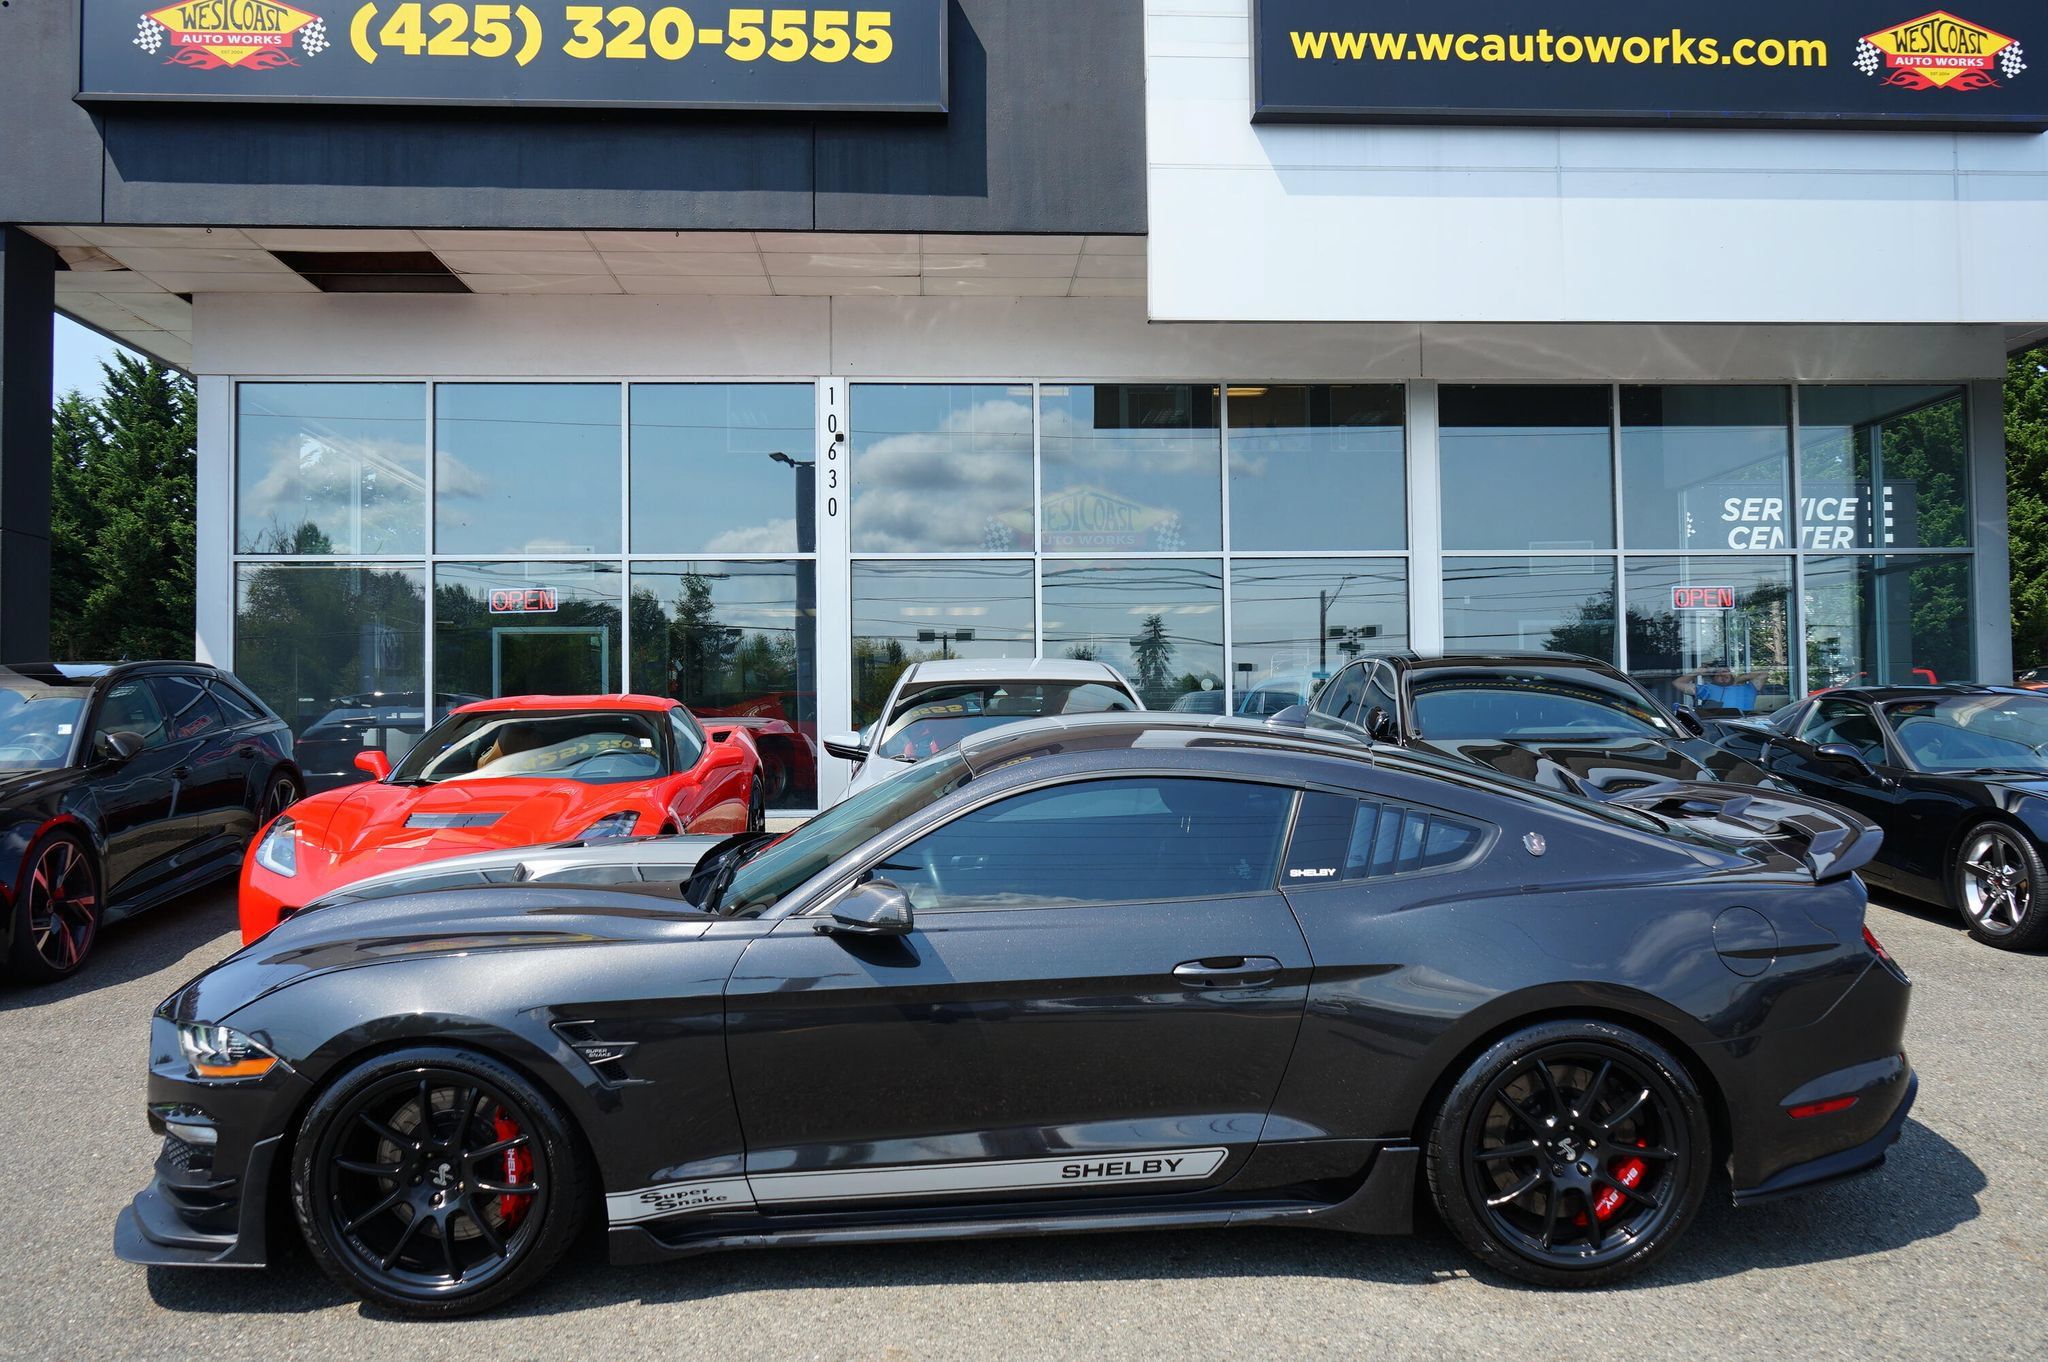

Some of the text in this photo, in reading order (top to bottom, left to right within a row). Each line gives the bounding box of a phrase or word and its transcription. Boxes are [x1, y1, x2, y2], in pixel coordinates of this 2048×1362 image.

[181, 34, 282, 44] AUTO WORKS
[350, 2, 893, 66] (425) 320-5555
[1290, 29, 1827, 67] www.wcautoworks.com
[1895, 57, 1984, 66] AUTO WORKS
[1721, 497, 1860, 521] SERICE
[1078, 535, 1136, 544] WORKS
[492, 589, 555, 611] OPEN
[1673, 588, 1733, 608] OPEN
[1289, 868, 1336, 877] SHELBY
[1061, 1158, 1184, 1179] SHELBY
[640, 1188, 710, 1204] Super
[654, 1195, 728, 1211] Snake
